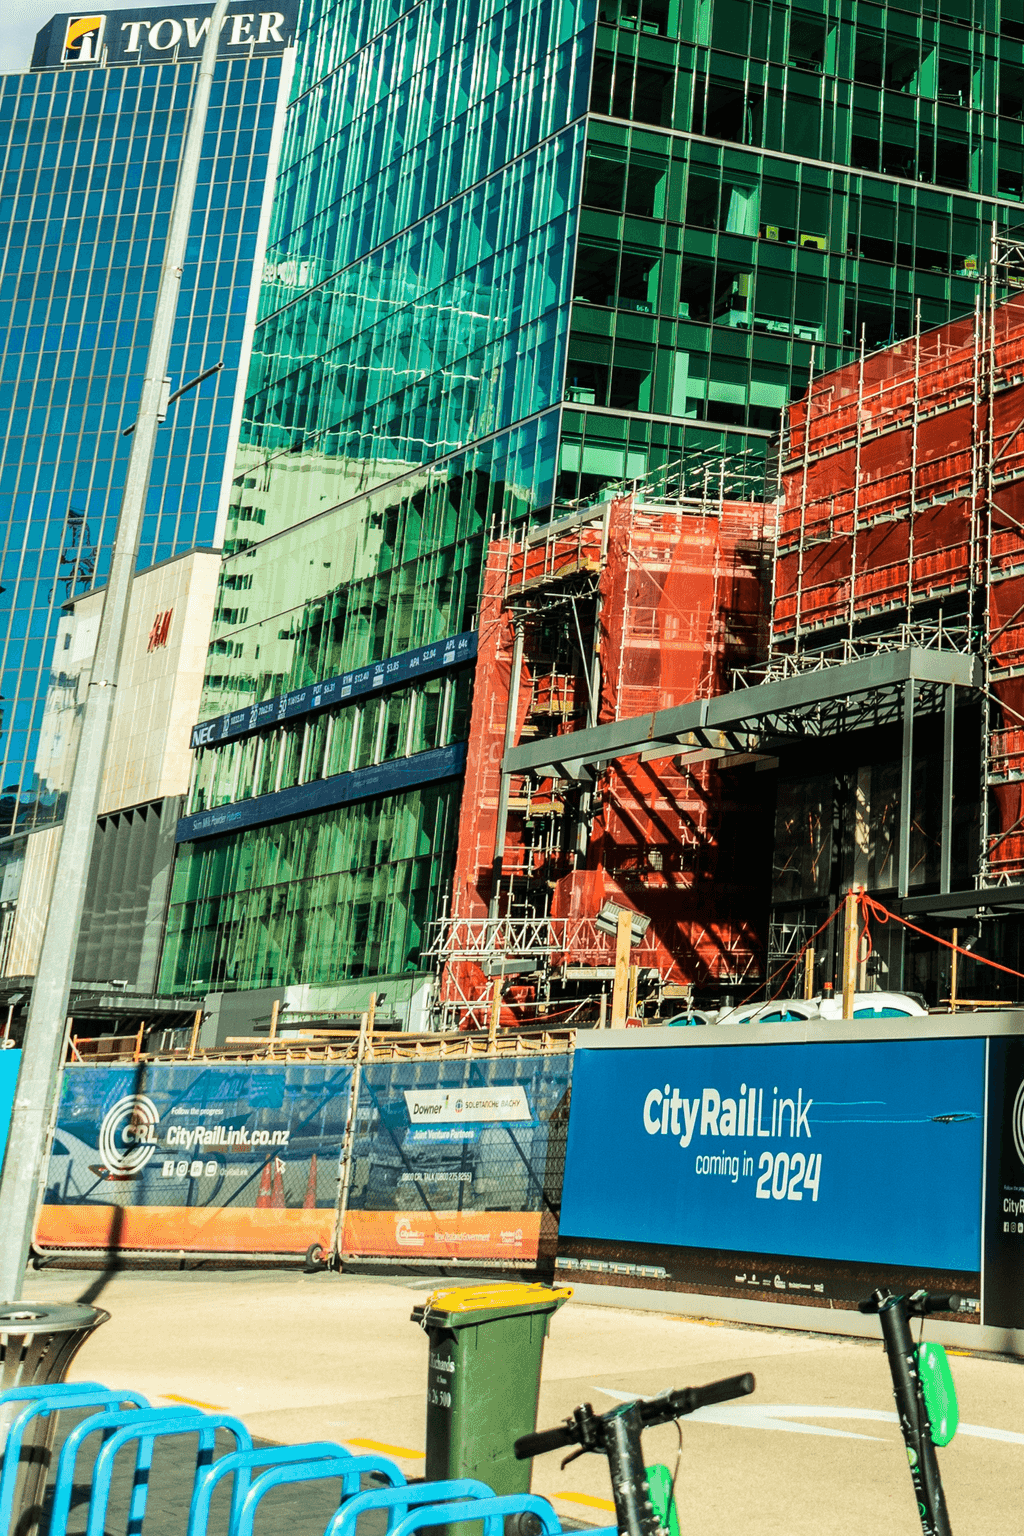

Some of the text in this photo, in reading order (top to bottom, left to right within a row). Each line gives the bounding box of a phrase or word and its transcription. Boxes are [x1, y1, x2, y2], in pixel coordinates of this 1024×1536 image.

[120, 11, 285, 53] TOWER
[191, 724, 216, 747] NEC
[413, 1102, 442, 1115] Downer
[121, 1124, 158, 1144] CRL
[166, 1125, 290, 1150] CityRailLink.co.nz
[695, 1149, 822, 1202] coming in 2024
